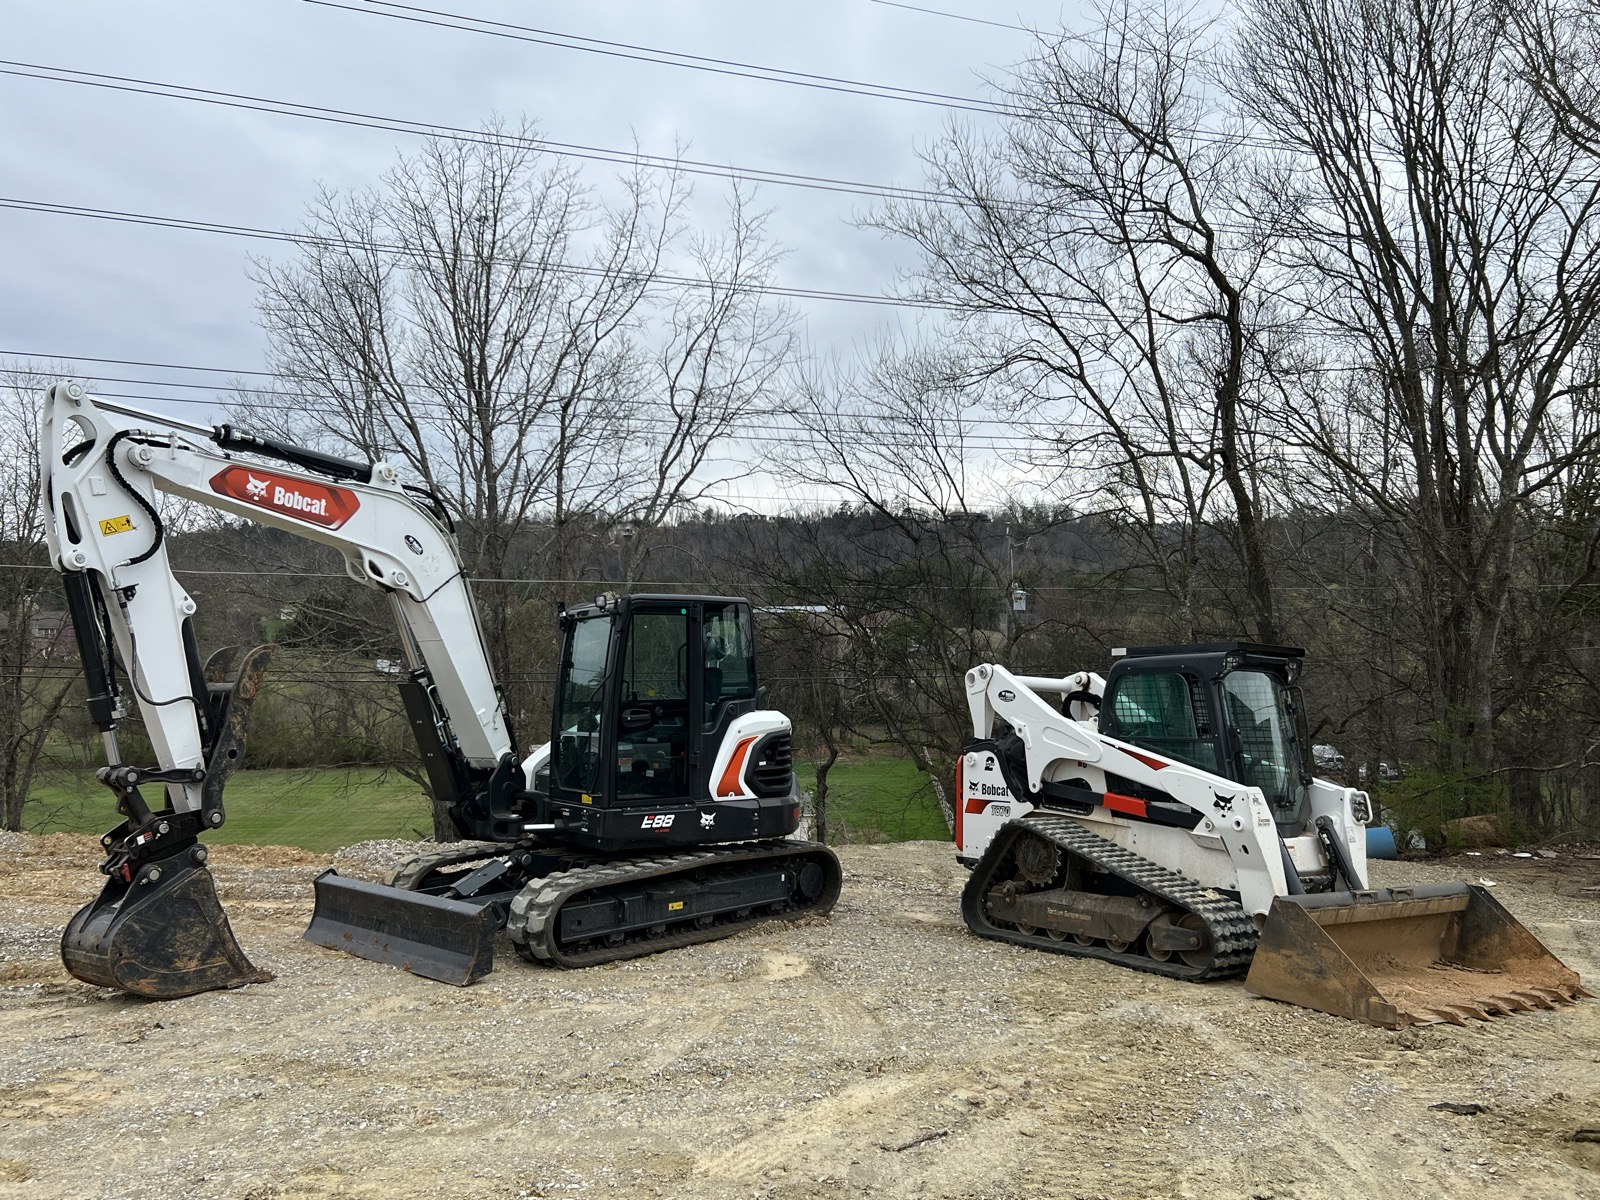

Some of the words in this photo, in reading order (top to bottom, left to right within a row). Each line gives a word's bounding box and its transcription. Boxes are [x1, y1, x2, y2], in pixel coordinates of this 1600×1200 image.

[273, 486, 327, 516] Bobcat
[981, 784, 1008, 796] Bobcat
[991, 805, 1010, 817] T870
[641, 814, 675, 828] E88
